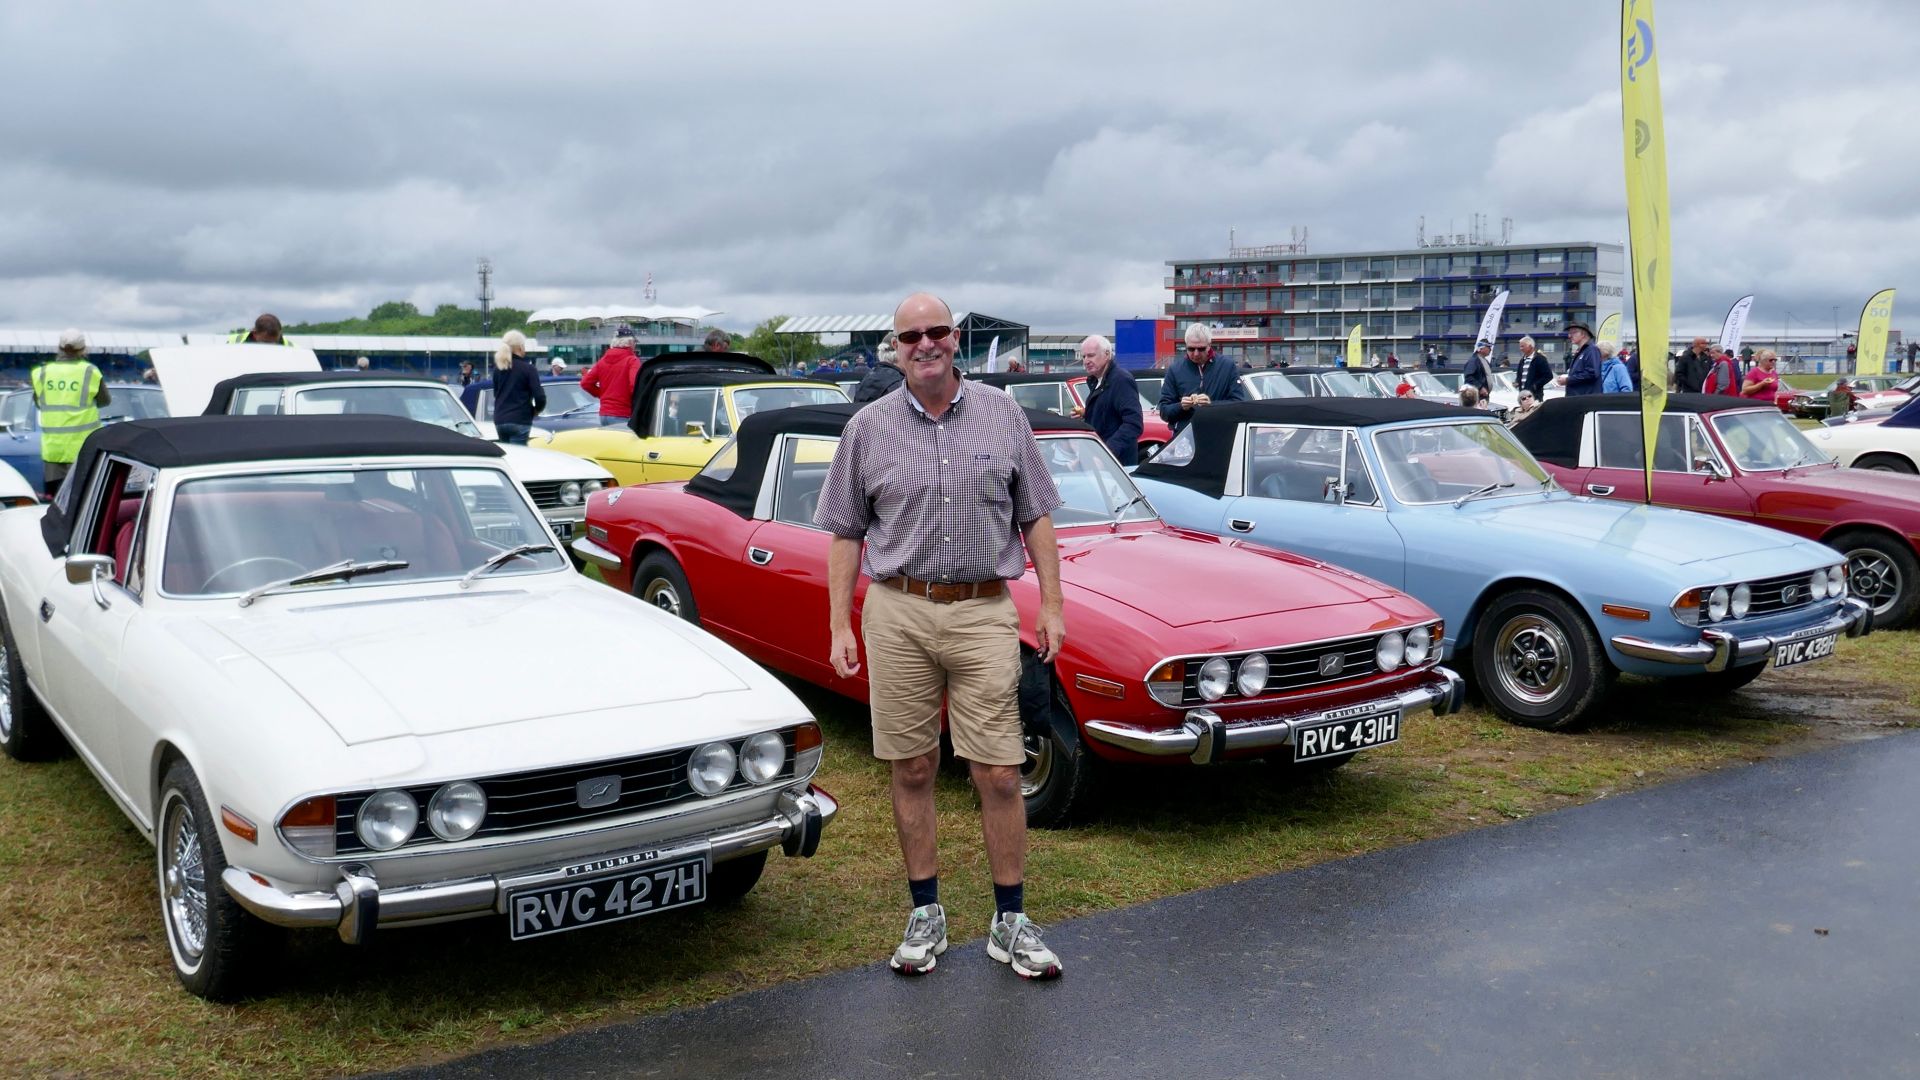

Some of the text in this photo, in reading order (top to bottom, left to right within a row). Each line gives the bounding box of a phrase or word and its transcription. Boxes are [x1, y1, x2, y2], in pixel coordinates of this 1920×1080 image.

[1486, 314, 1494, 328] Club
[1731, 309, 1740, 326] Club
[1871, 307, 1888, 318] 50
[552, 524, 572, 540] 2L
[1776, 642, 1804, 666] RVC
[1329, 705, 1374, 718] TRIUMPH
[1302, 715, 1396, 756] RVC 431H
[571, 851, 655, 874] TRIUMPH
[517, 863, 700, 933] RVC 427H
